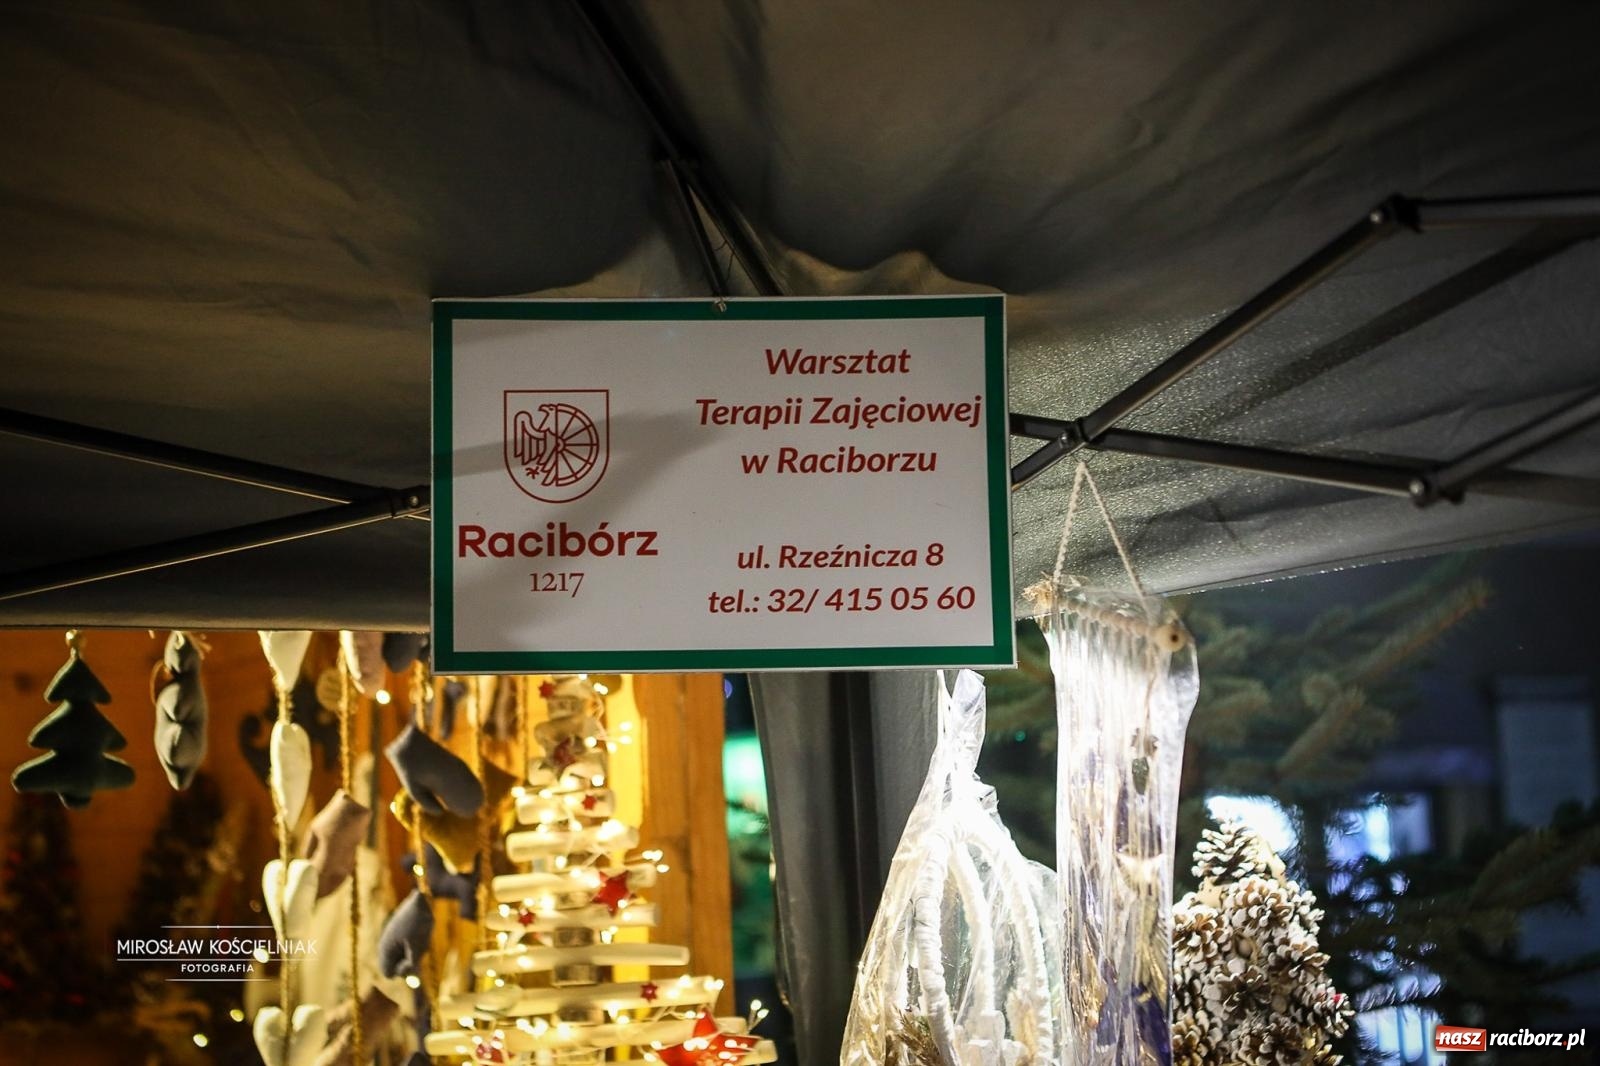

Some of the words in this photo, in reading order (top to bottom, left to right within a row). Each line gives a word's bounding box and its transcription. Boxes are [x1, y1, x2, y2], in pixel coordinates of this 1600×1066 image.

[765, 349, 911, 376] Warsztat
[696, 397, 802, 430] Terapii
[809, 395, 982, 429] Zajęciowej
[741, 455, 769, 475] w
[776, 446, 938, 474] Raciborzu
[458, 522, 659, 559] Racibórz
[737, 545, 770, 570] ul.
[778, 544, 918, 569] Rzeźnicza
[924, 543, 944, 567] 8
[529, 571, 585, 598] 1217
[708, 588, 759, 613] tel.:
[767, 588, 820, 613] 32/
[824, 587, 882, 612] 415
[890, 586, 929, 611] 05
[935, 585, 975, 610] 60
